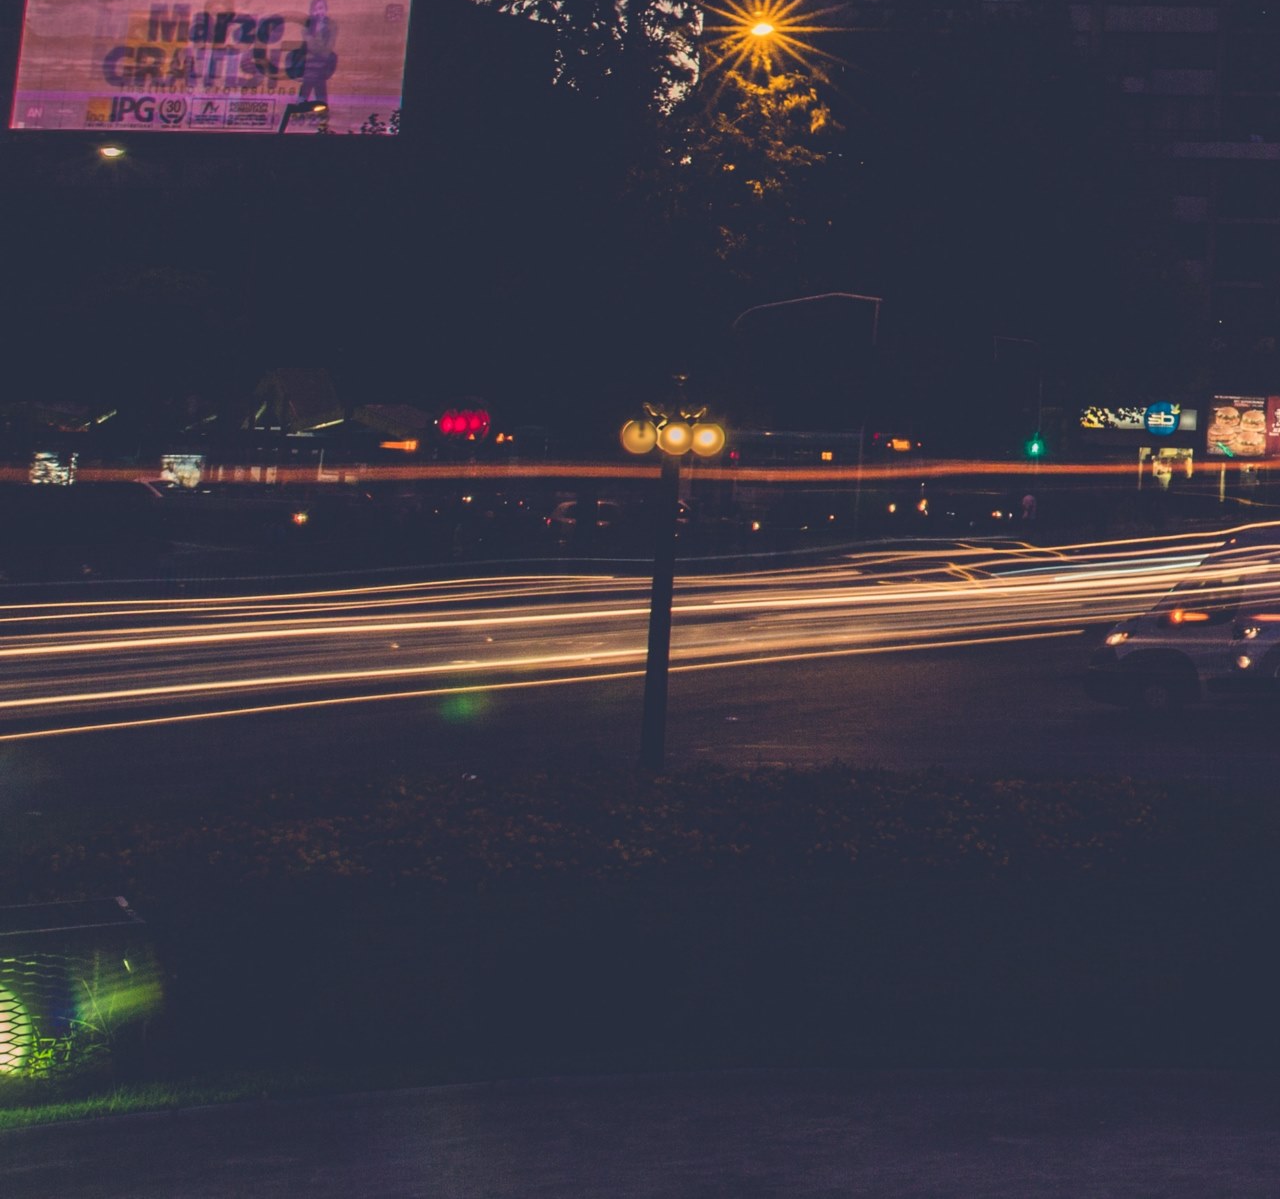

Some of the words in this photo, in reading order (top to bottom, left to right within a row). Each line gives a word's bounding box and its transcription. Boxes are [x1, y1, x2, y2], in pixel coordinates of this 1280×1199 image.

[147, 3, 285, 43] Marzo
[111, 96, 156, 123] IPG
[166, 100, 182, 113] 30
